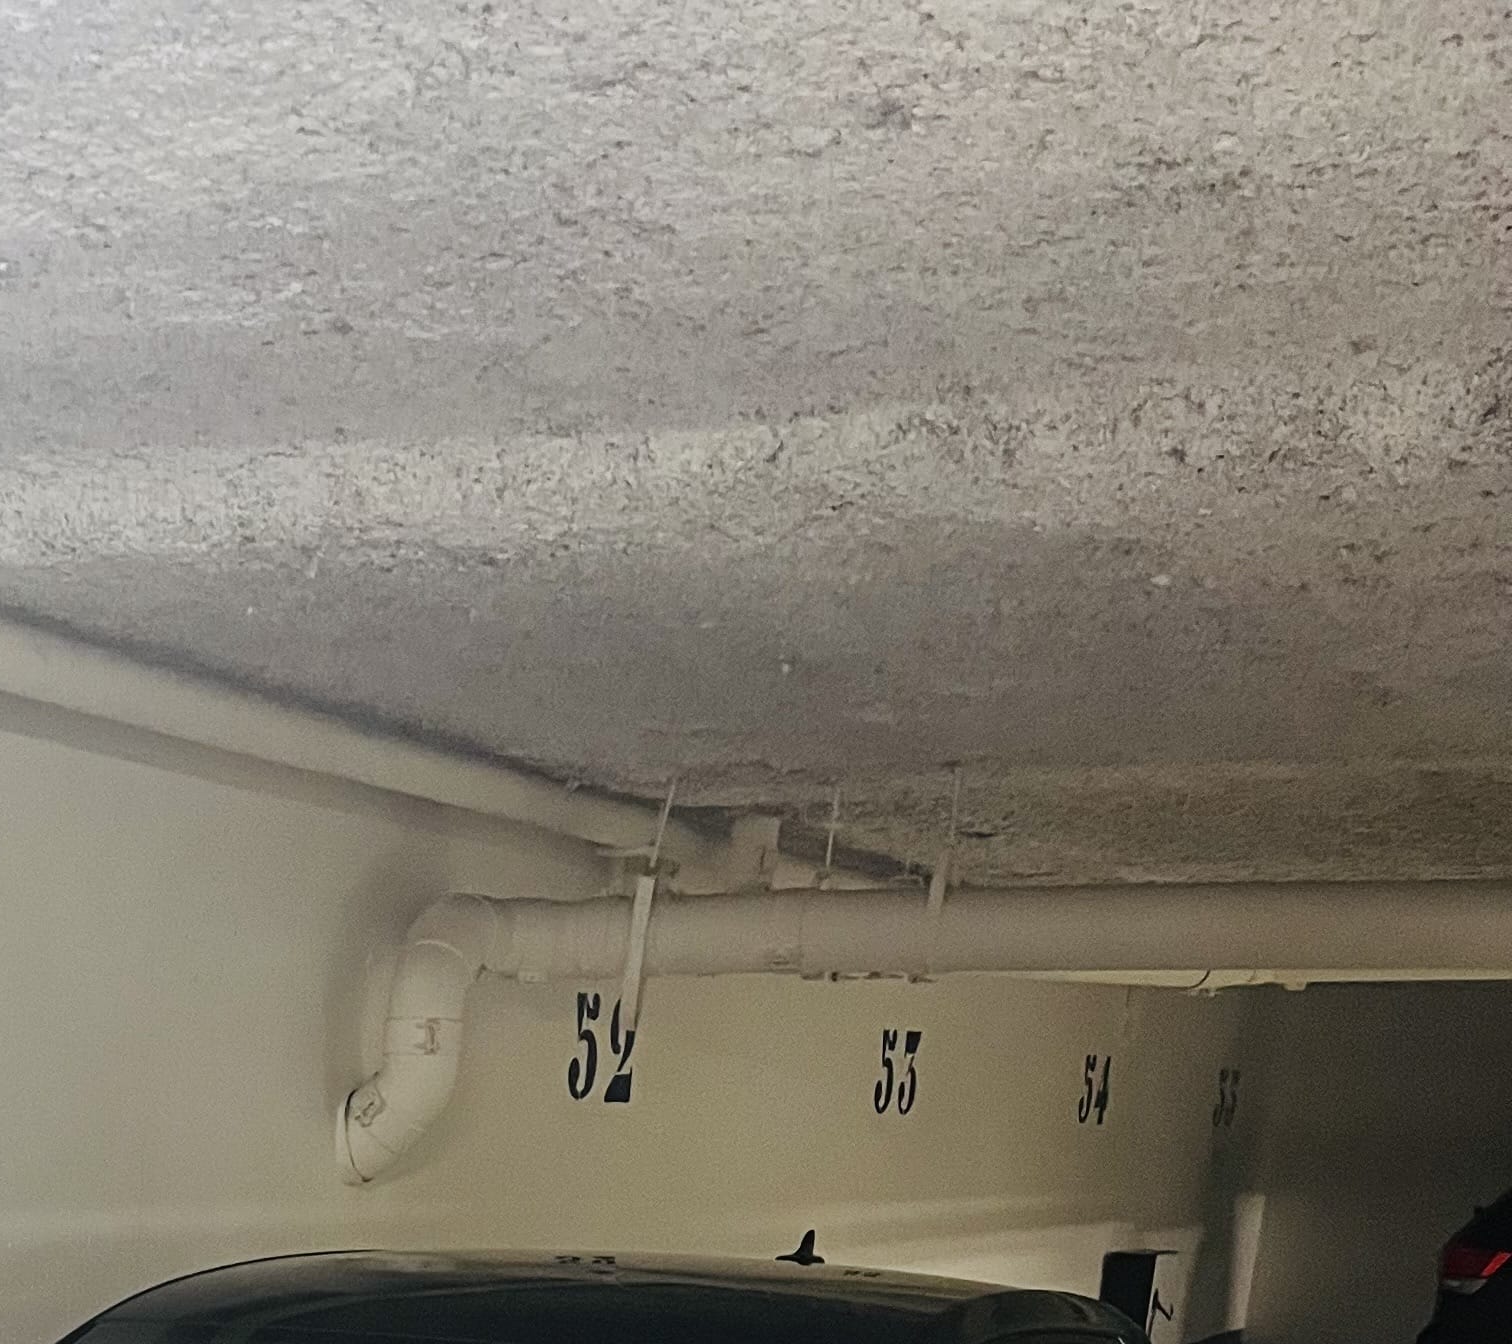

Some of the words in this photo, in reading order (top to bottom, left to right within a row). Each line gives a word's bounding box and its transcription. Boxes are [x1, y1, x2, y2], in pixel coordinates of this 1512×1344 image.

[567, 991, 636, 1103] 52
[874, 1028, 922, 1114] 53
[1078, 1054, 1111, 1125] 54
